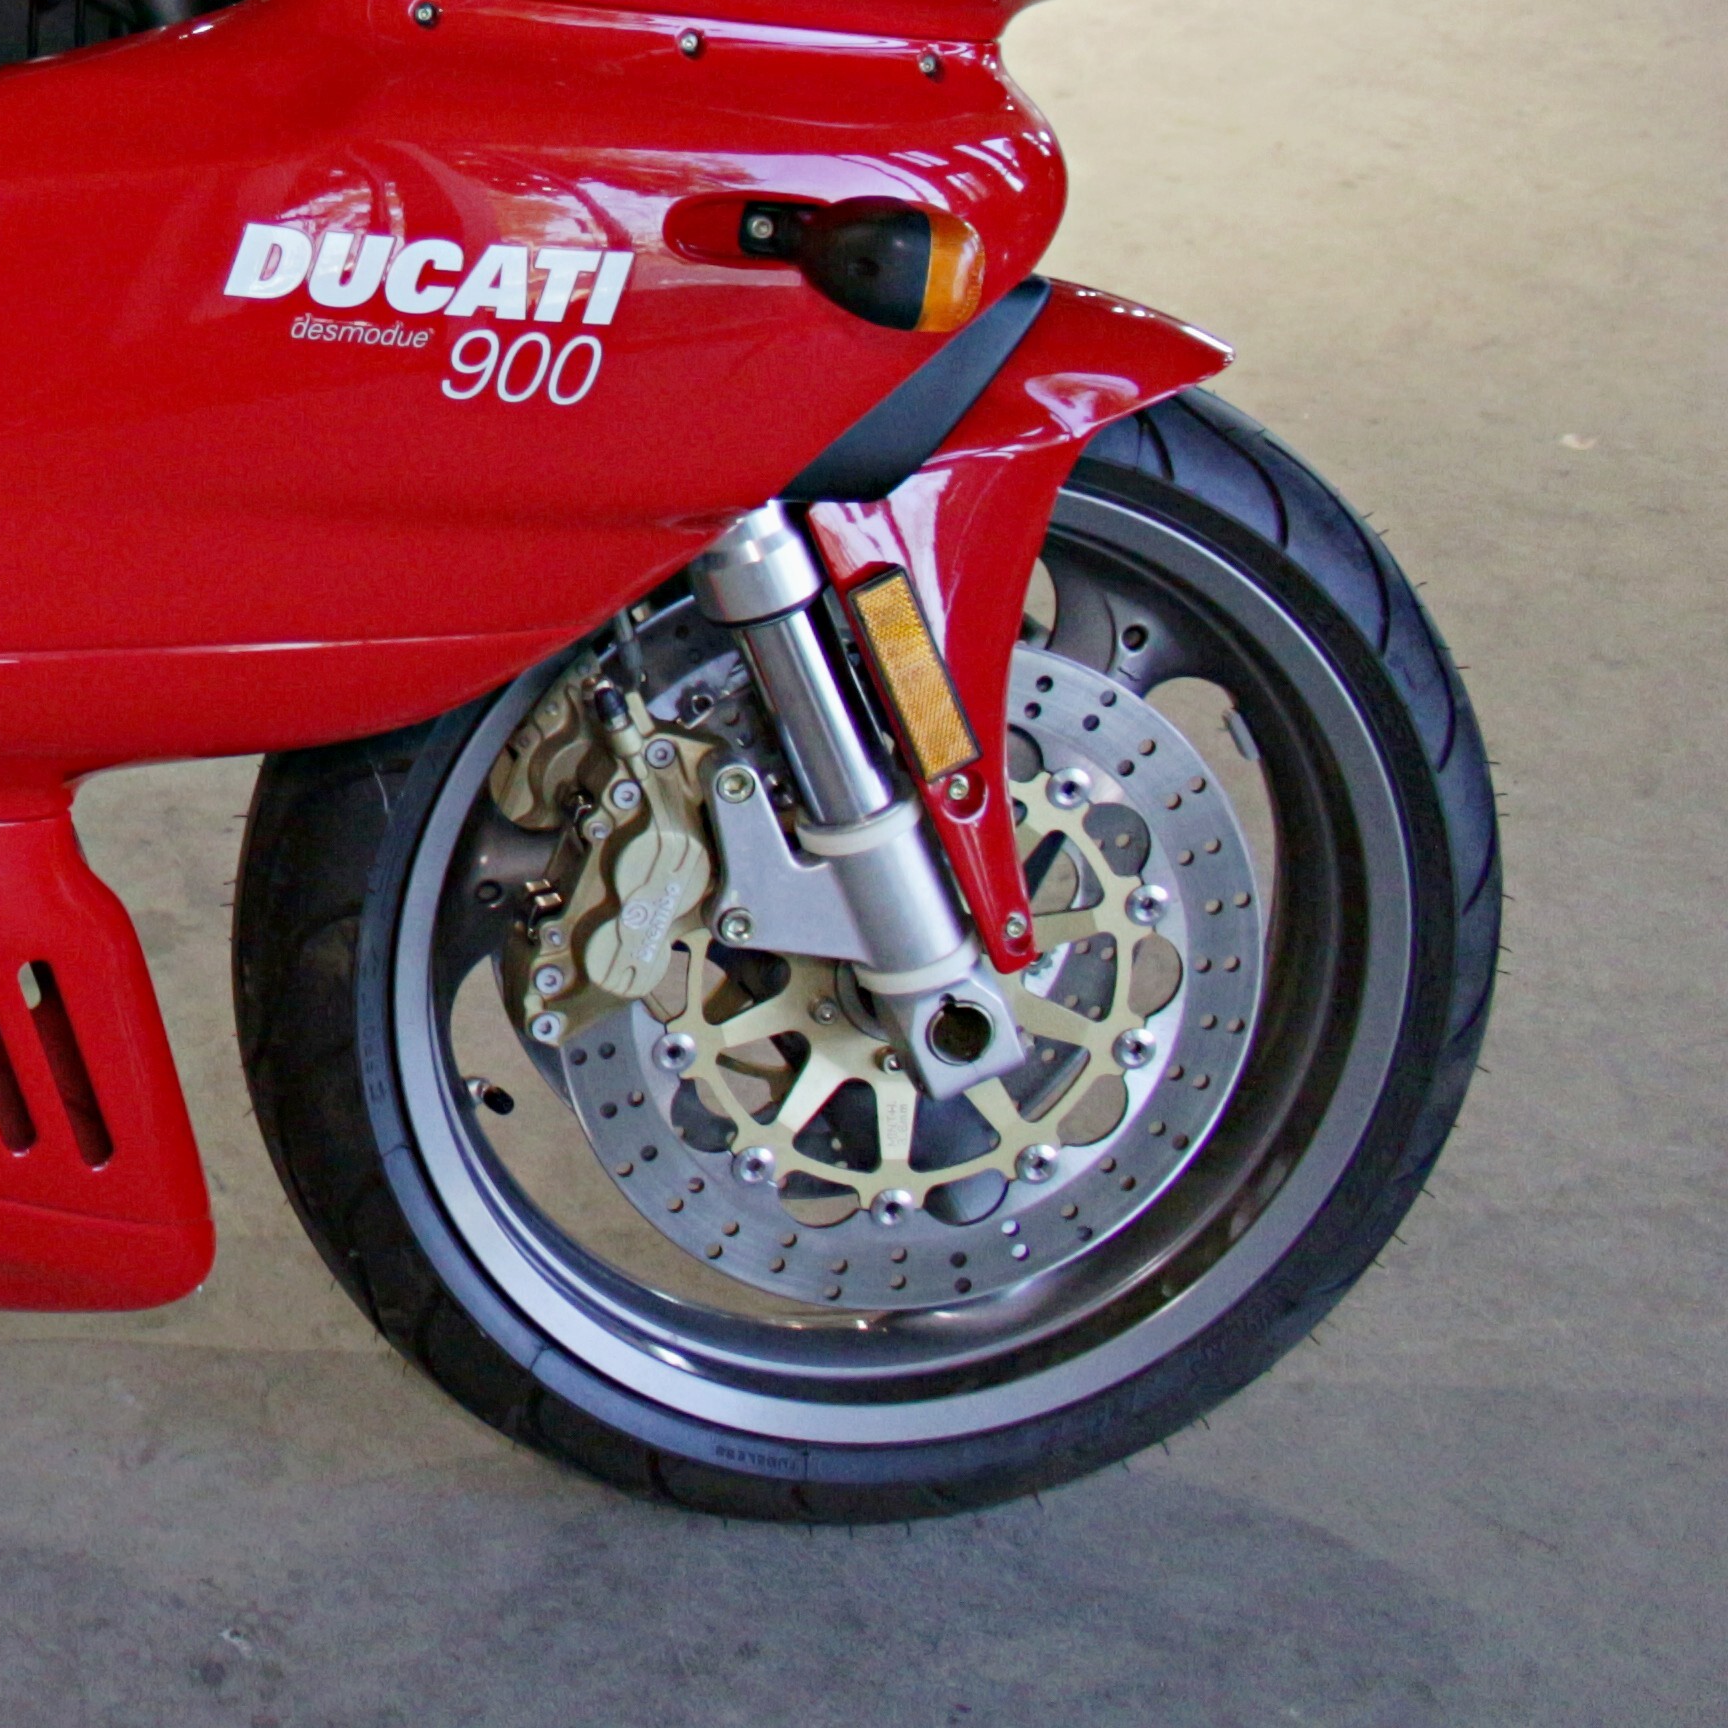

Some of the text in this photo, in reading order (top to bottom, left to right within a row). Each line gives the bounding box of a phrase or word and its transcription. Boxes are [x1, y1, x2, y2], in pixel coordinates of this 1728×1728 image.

[224, 222, 635, 326] DUCATI
[290, 313, 433, 349] desmodue
[441, 328, 603, 406] 900
